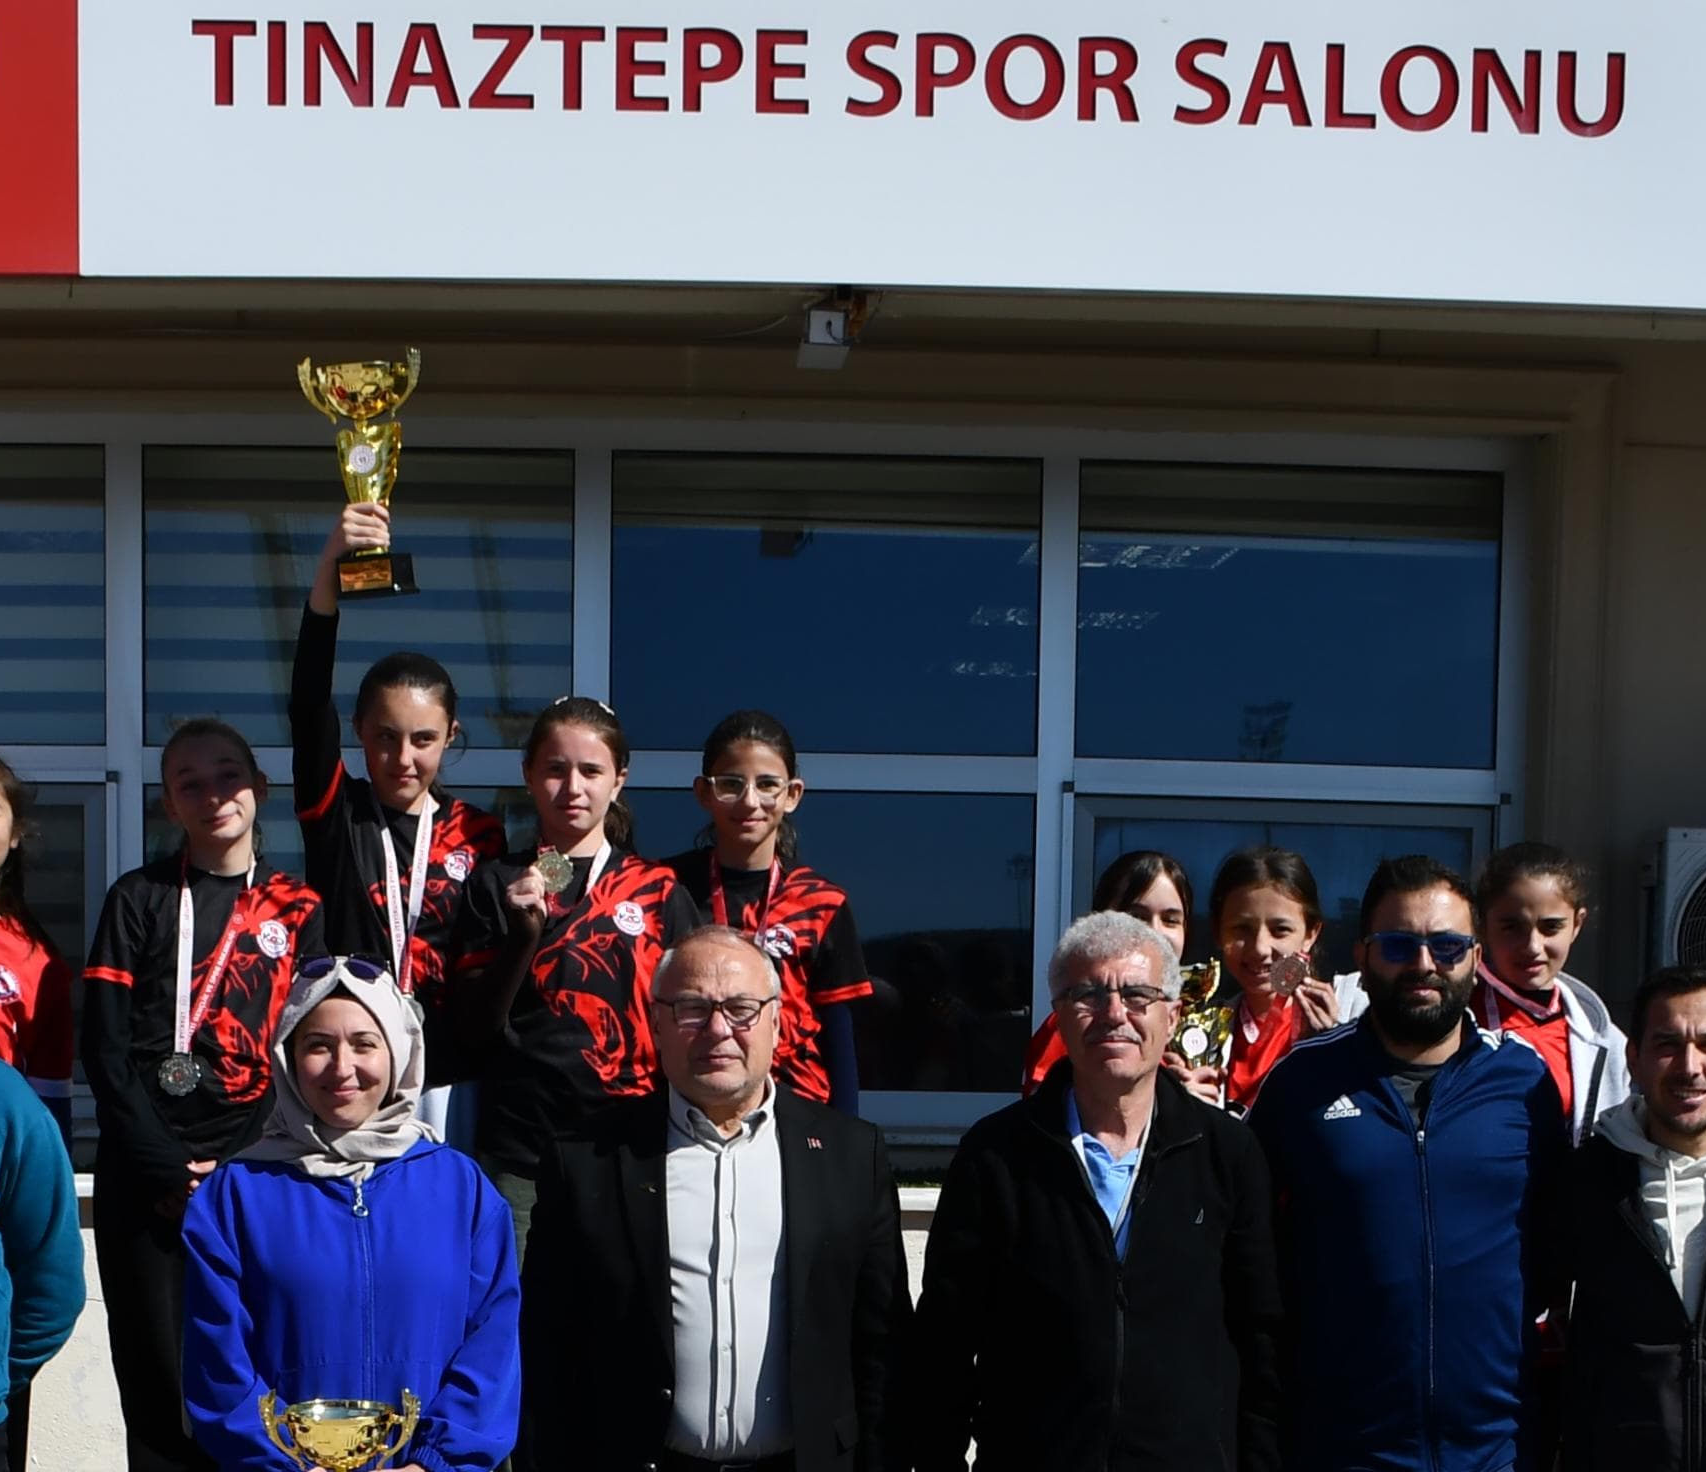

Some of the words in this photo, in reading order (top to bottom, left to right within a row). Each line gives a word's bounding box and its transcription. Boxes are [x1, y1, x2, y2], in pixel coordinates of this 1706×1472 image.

[192, 19, 812, 115] TINAZTEPE
[843, 28, 1141, 124] SPOR
[1172, 36, 1629, 141] SALONU
[1324, 1108, 1361, 1120] adidas
